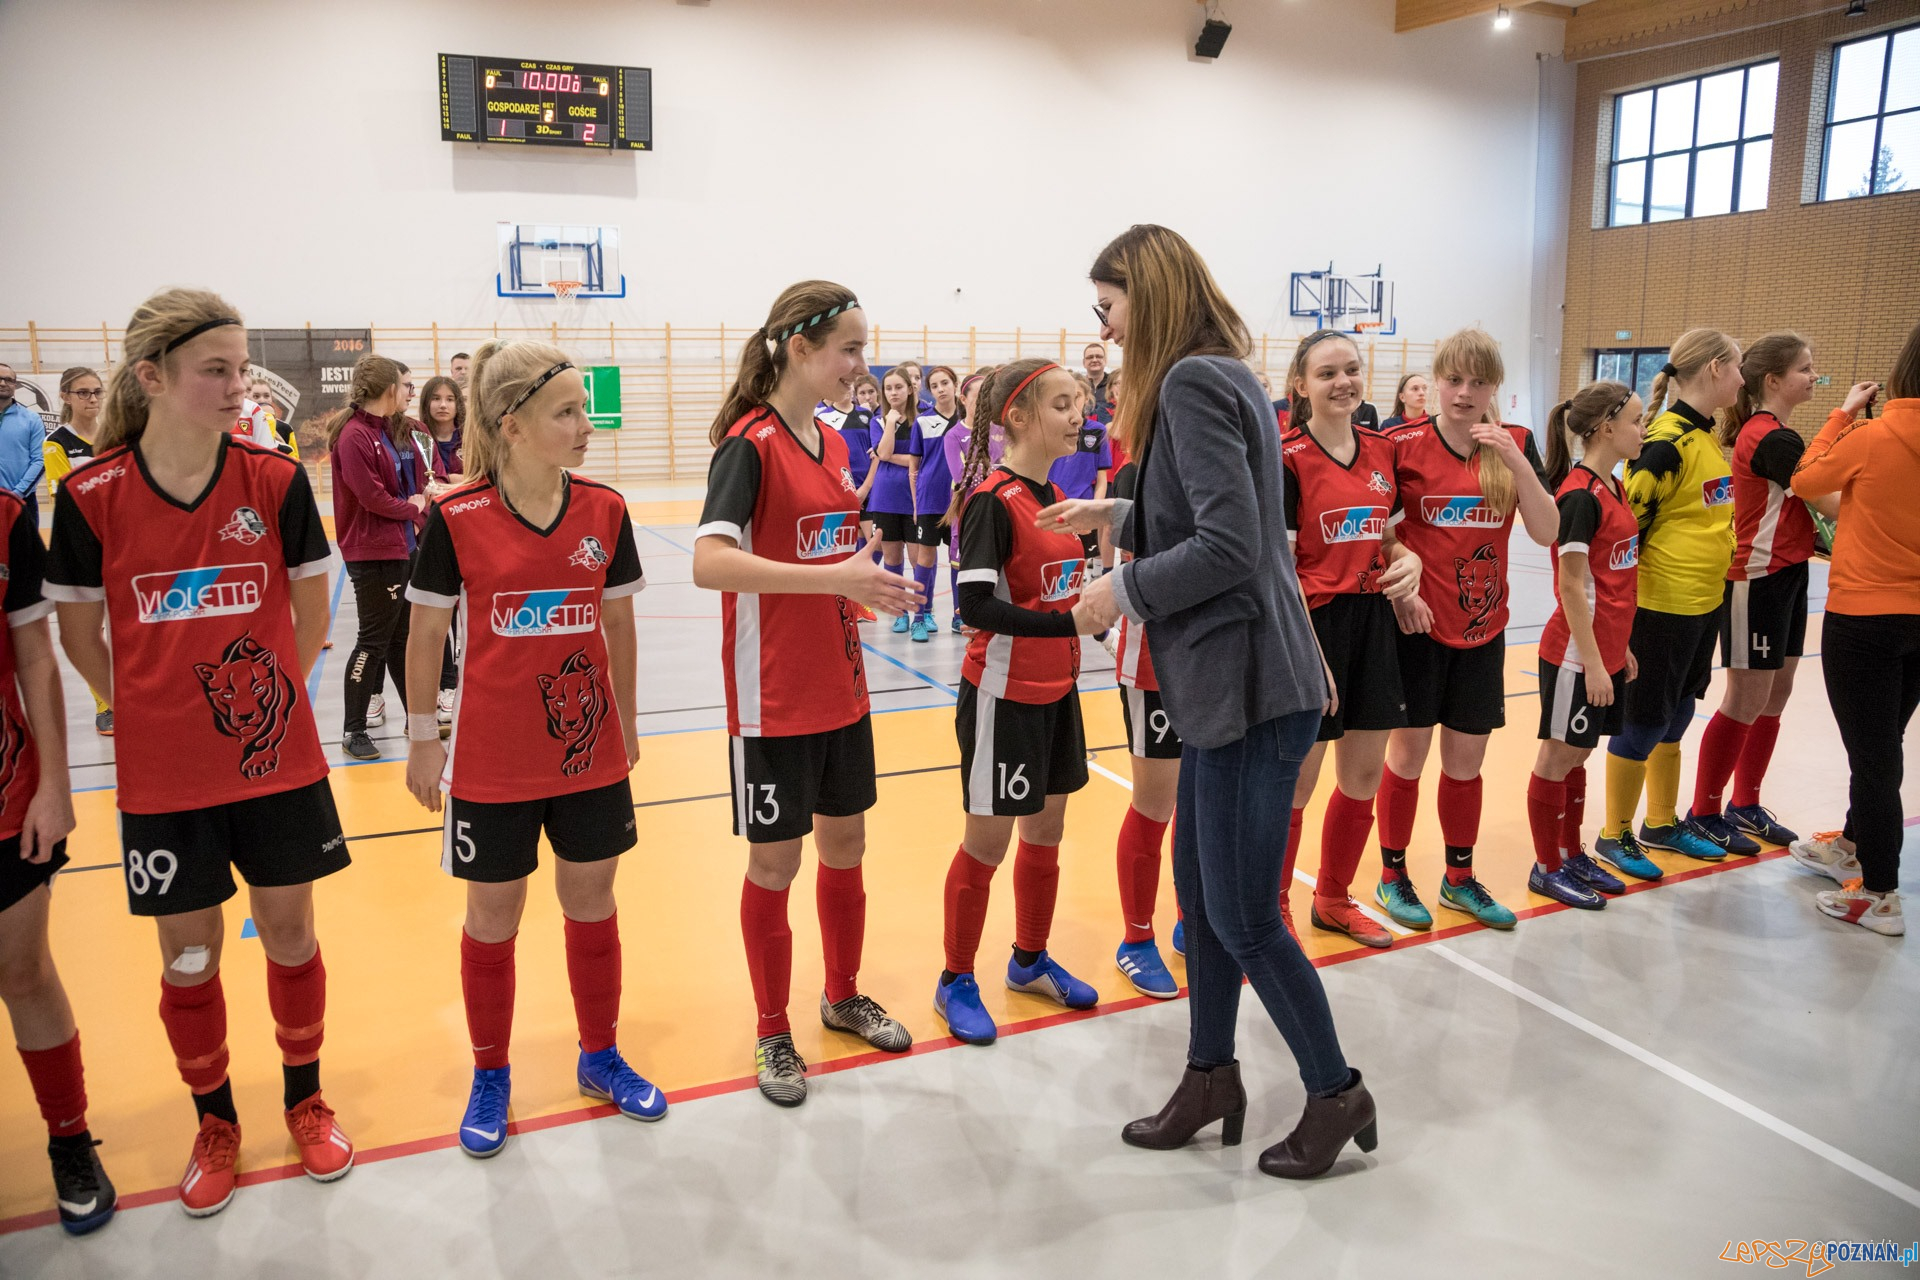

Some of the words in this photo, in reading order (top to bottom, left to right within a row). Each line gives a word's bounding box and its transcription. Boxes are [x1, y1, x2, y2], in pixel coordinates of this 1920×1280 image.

[486, 75, 495, 88] 0
[600, 82, 608, 96] 0
[488, 102, 540, 114] GOSPODARZE
[568, 105, 596, 118] GOŚCIE
[583, 124, 596, 141] 2
[333, 340, 364, 352] 2016
[800, 526, 856, 552] VIOLETT
[140, 580, 259, 615] VIOLETTA
[390, 592, 398, 600] 16
[494, 603, 594, 628] VIOLETTA
[1752, 632, 1770, 658] 4
[1570, 706, 1588, 734] 6
[998, 762, 1030, 800] 16
[746, 783, 780, 825] 13
[456, 820, 476, 863] 5
[128, 849, 178, 896] 89
